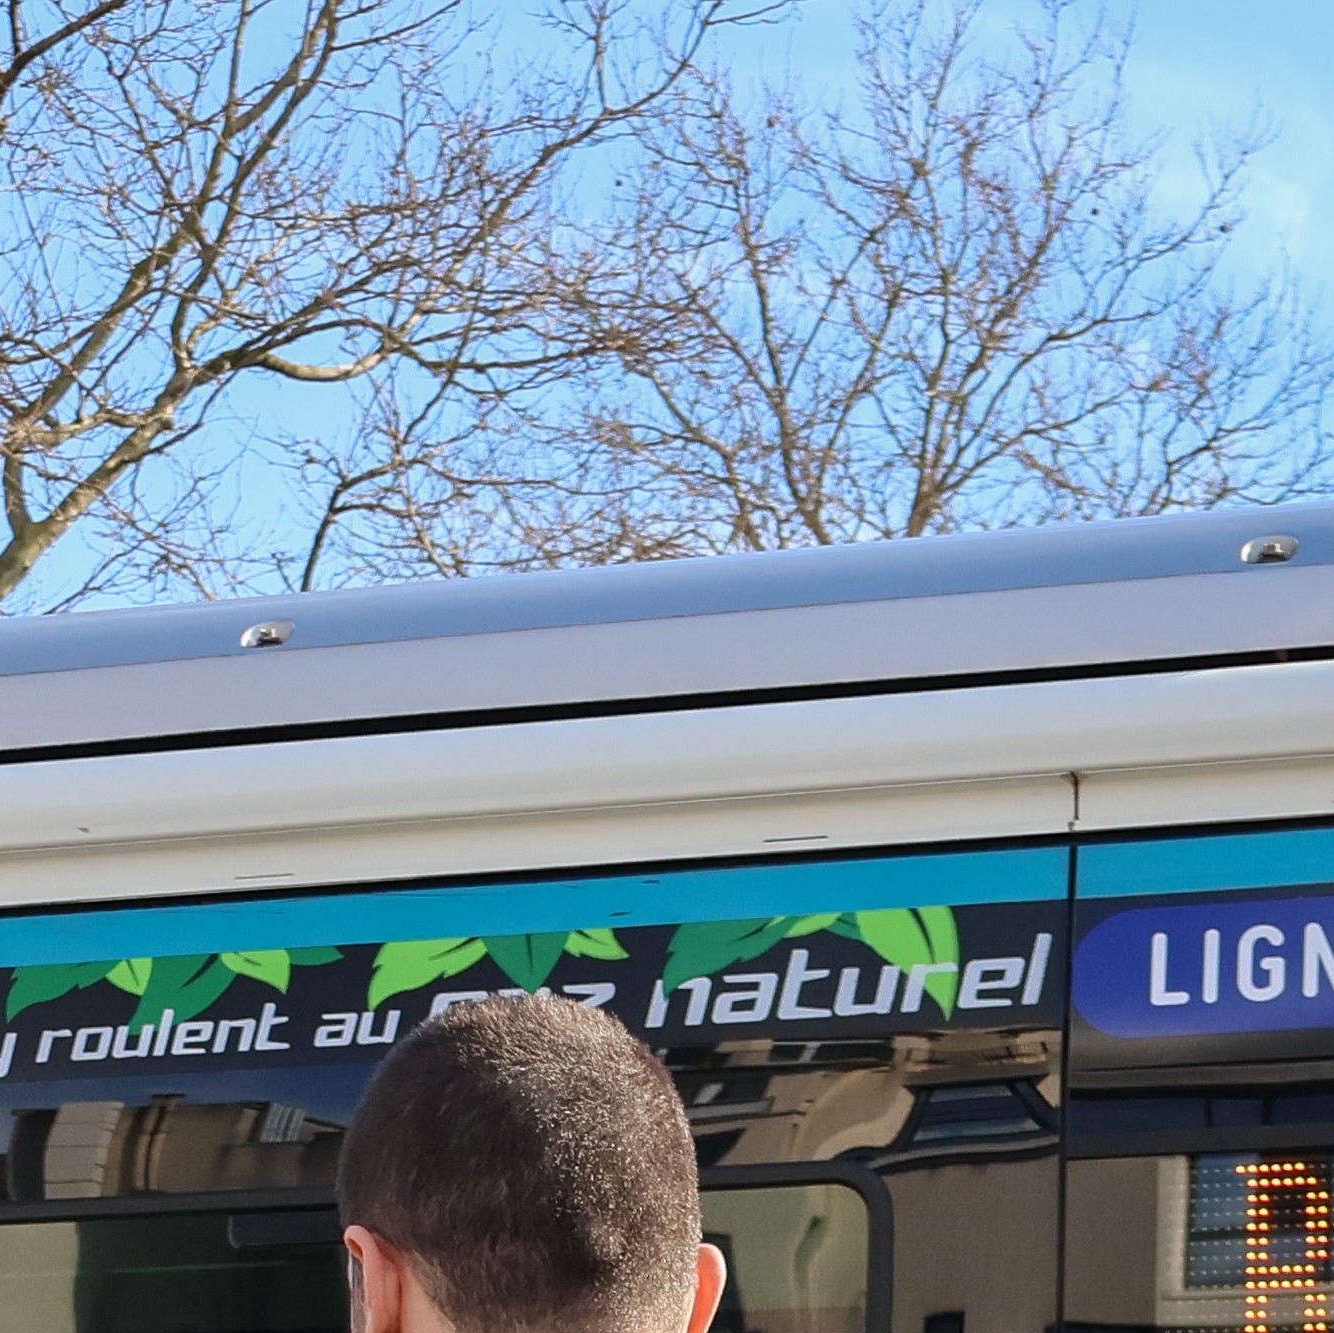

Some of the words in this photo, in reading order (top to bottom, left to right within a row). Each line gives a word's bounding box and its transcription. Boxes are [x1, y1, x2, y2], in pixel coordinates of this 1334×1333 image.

[35, 1002, 290, 1063] roulent
[313, 1008, 402, 1049] au
[643, 932, 1054, 1029] naturel
